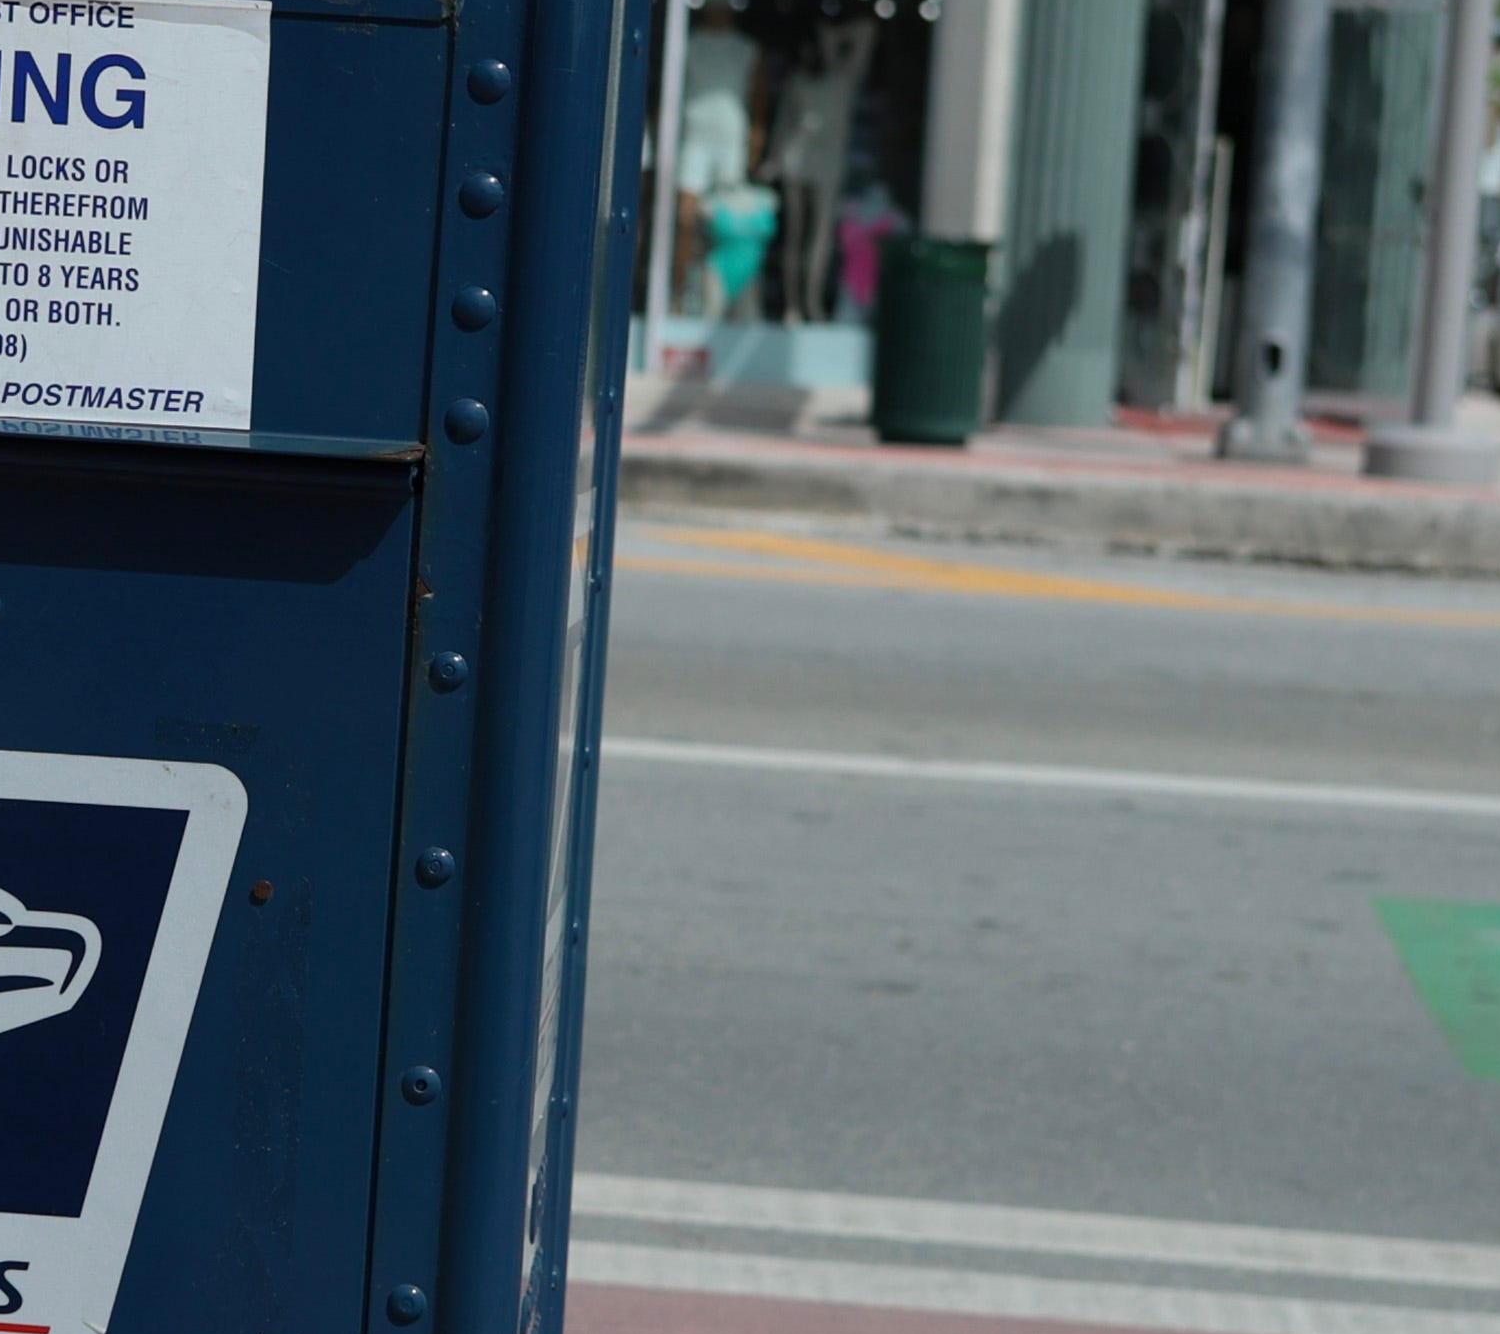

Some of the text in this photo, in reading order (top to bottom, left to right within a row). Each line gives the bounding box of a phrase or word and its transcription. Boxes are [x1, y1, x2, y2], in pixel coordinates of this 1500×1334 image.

[29, 1, 135, 30] OFFICE
[7, 154, 86, 182] LOCKS
[95, 158, 129, 184] OR
[37, 264, 51, 288] 8
[60, 265, 139, 292] YEARS
[5, 298, 39, 323] OR
[48, 300, 121, 327] BOTH.
[1, 382, 204, 413] POSTMASTER
